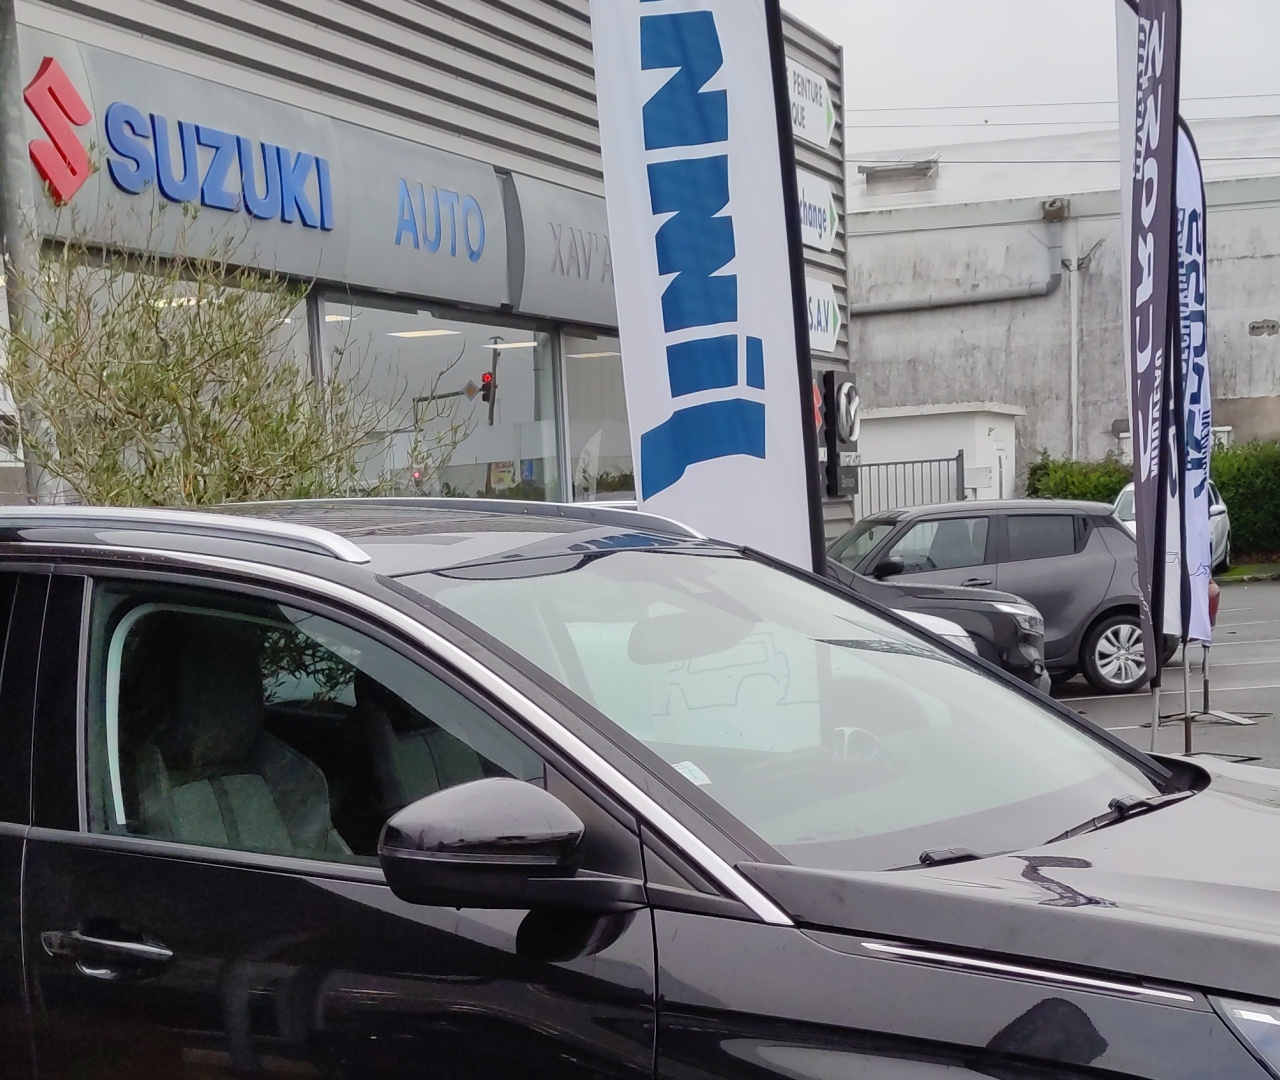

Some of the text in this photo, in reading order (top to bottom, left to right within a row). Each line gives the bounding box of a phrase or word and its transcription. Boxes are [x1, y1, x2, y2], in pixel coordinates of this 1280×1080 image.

[793, 71, 823, 107] PEINTURE
[105, 101, 336, 231] SUZUKI
[394, 177, 486, 262] AUTO
